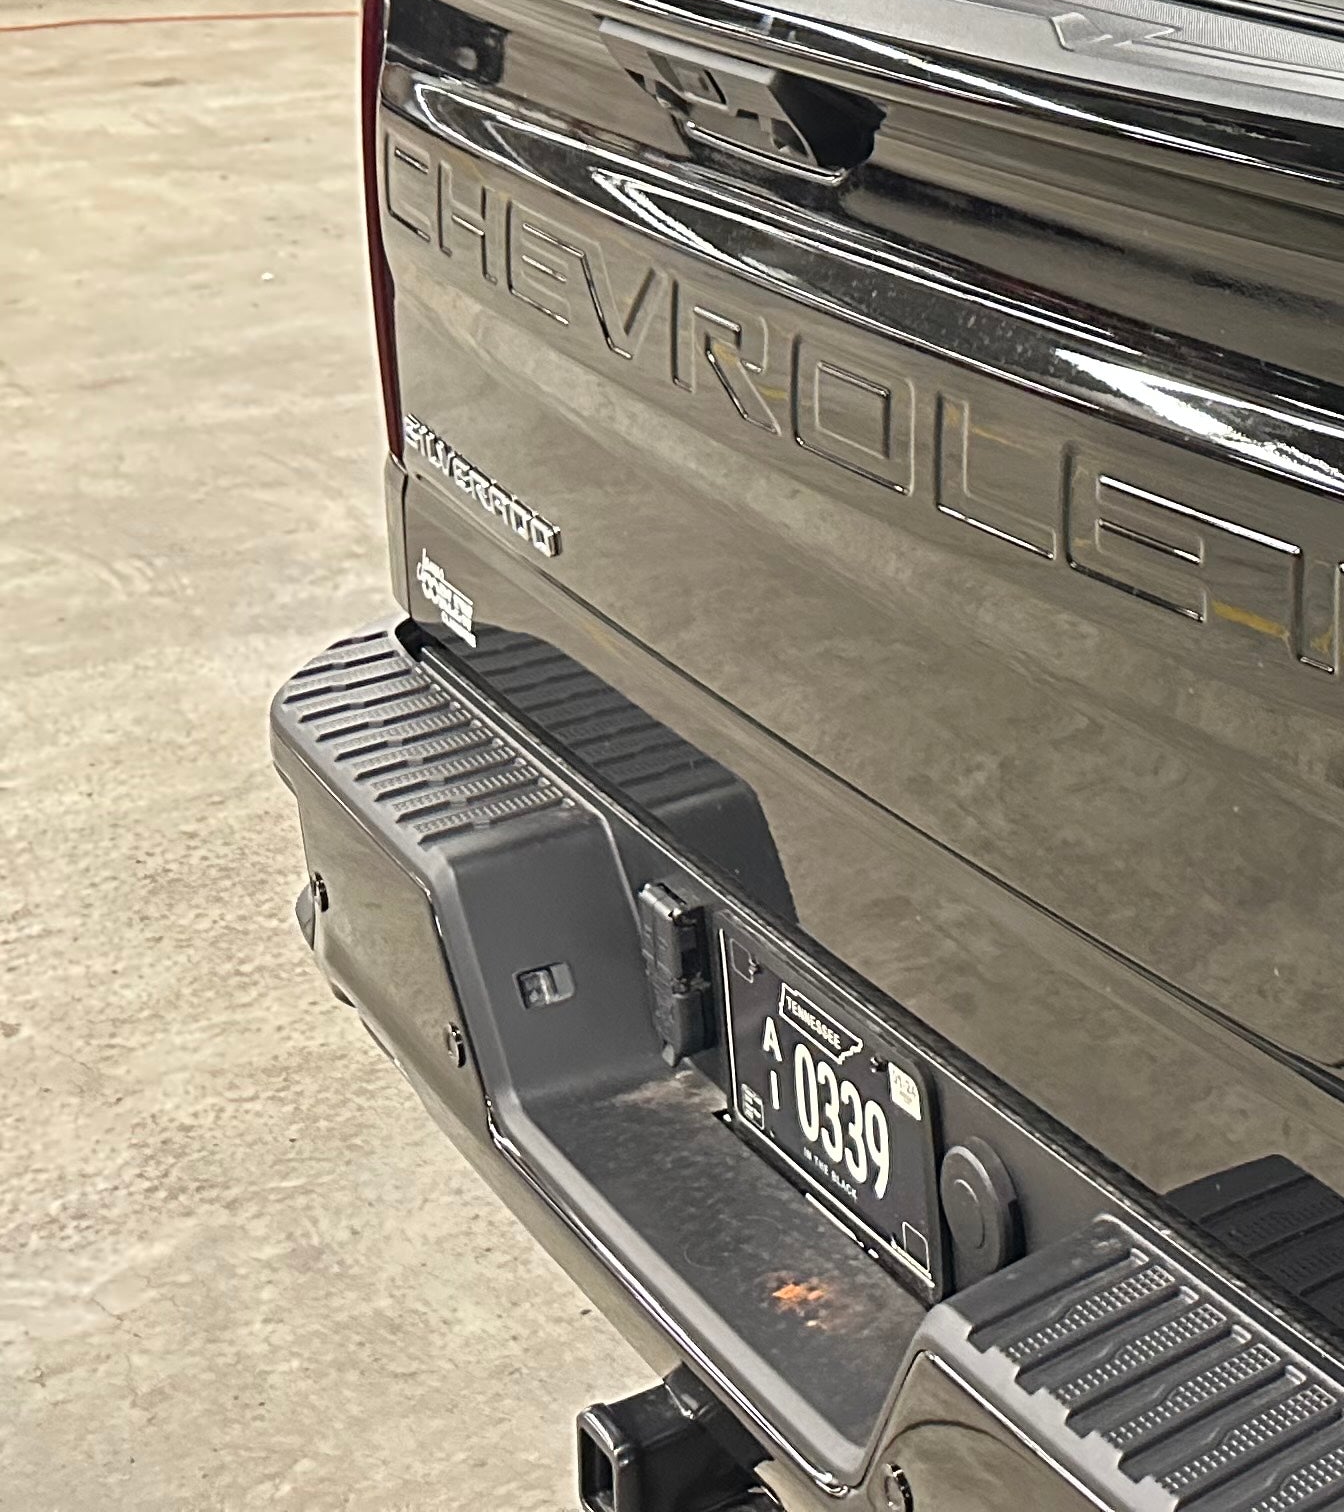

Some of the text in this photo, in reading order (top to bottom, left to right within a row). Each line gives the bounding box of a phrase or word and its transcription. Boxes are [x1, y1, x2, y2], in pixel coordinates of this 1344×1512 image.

[404, 412, 562, 557] SILVERADO
[785, 995, 842, 1051] TENNESSEE
[794, 1043, 890, 1200] 0339
[813, 1154, 829, 1176] THE
[831, 1169, 858, 1203] BLACK
